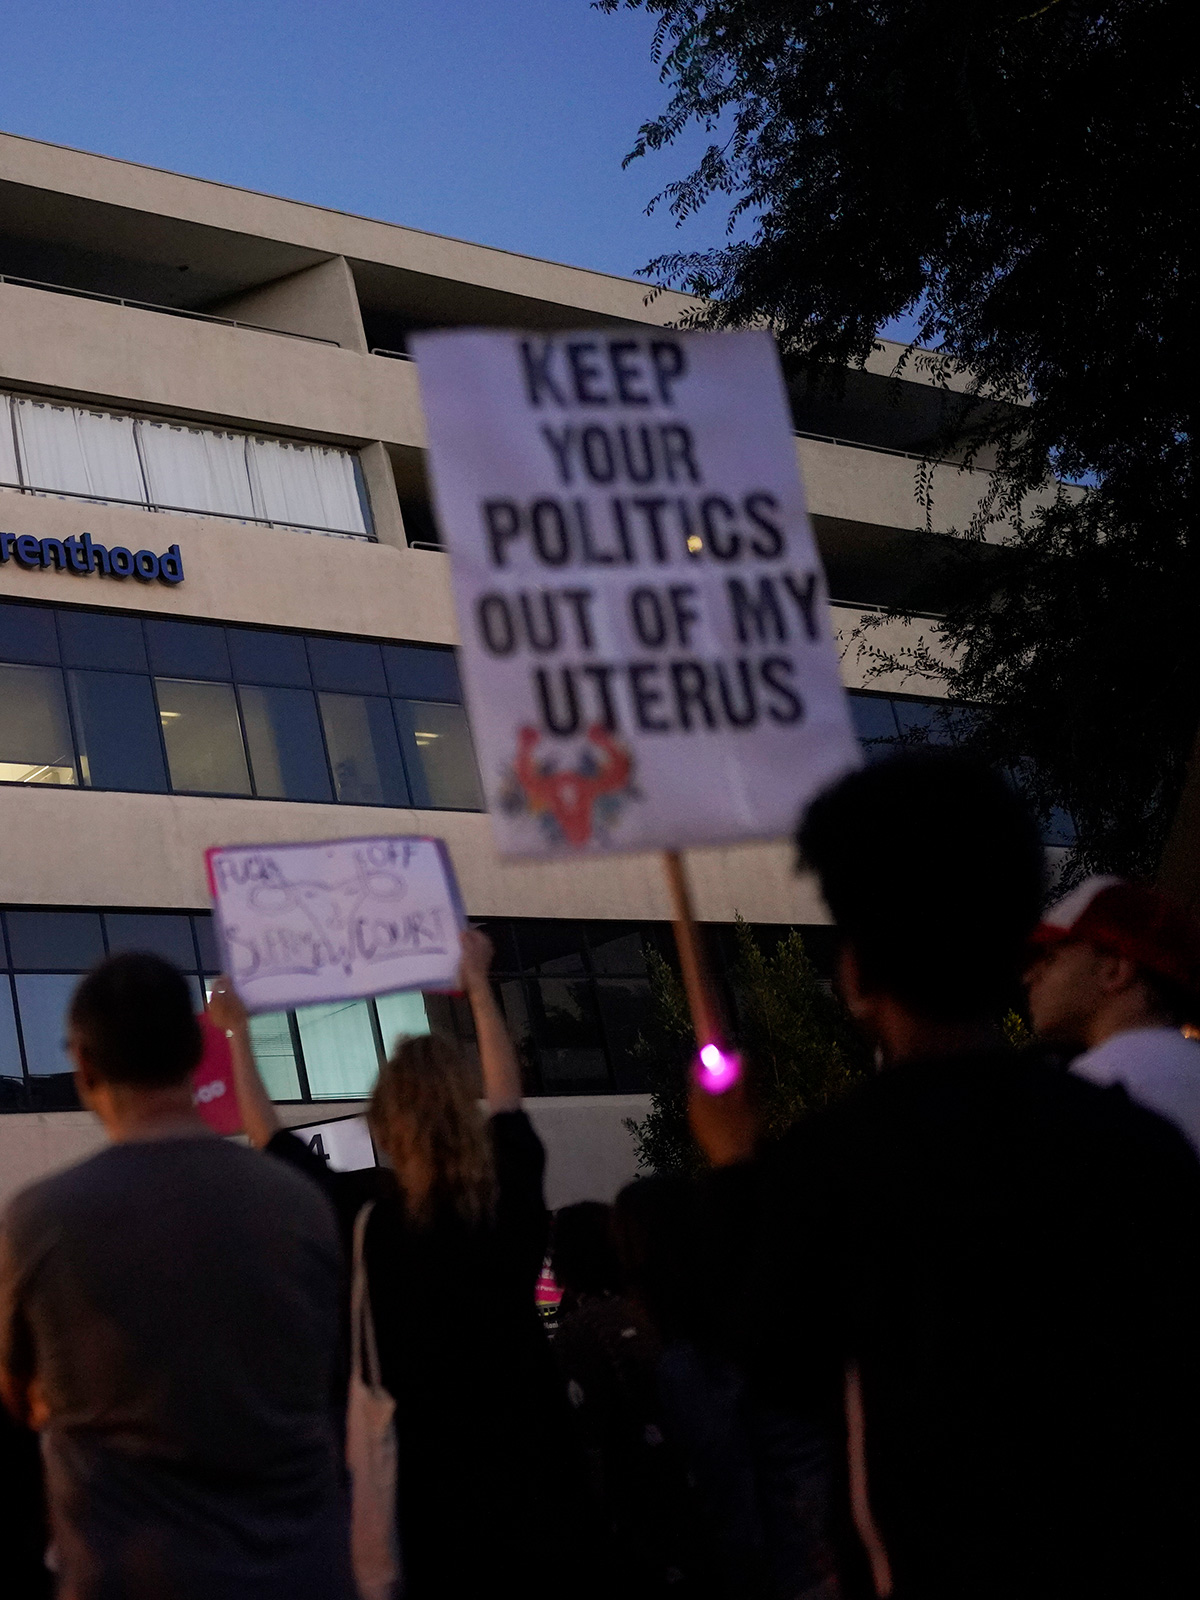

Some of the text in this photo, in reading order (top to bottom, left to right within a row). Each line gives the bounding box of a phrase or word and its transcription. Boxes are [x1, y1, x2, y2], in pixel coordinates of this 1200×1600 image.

[518, 339, 689, 409] KEEP
[541, 421, 699, 487] YOUR
[482, 491, 784, 571] POLITICS
[475, 571, 823, 659] OUT OF MY
[532, 655, 807, 739] UTERUS
